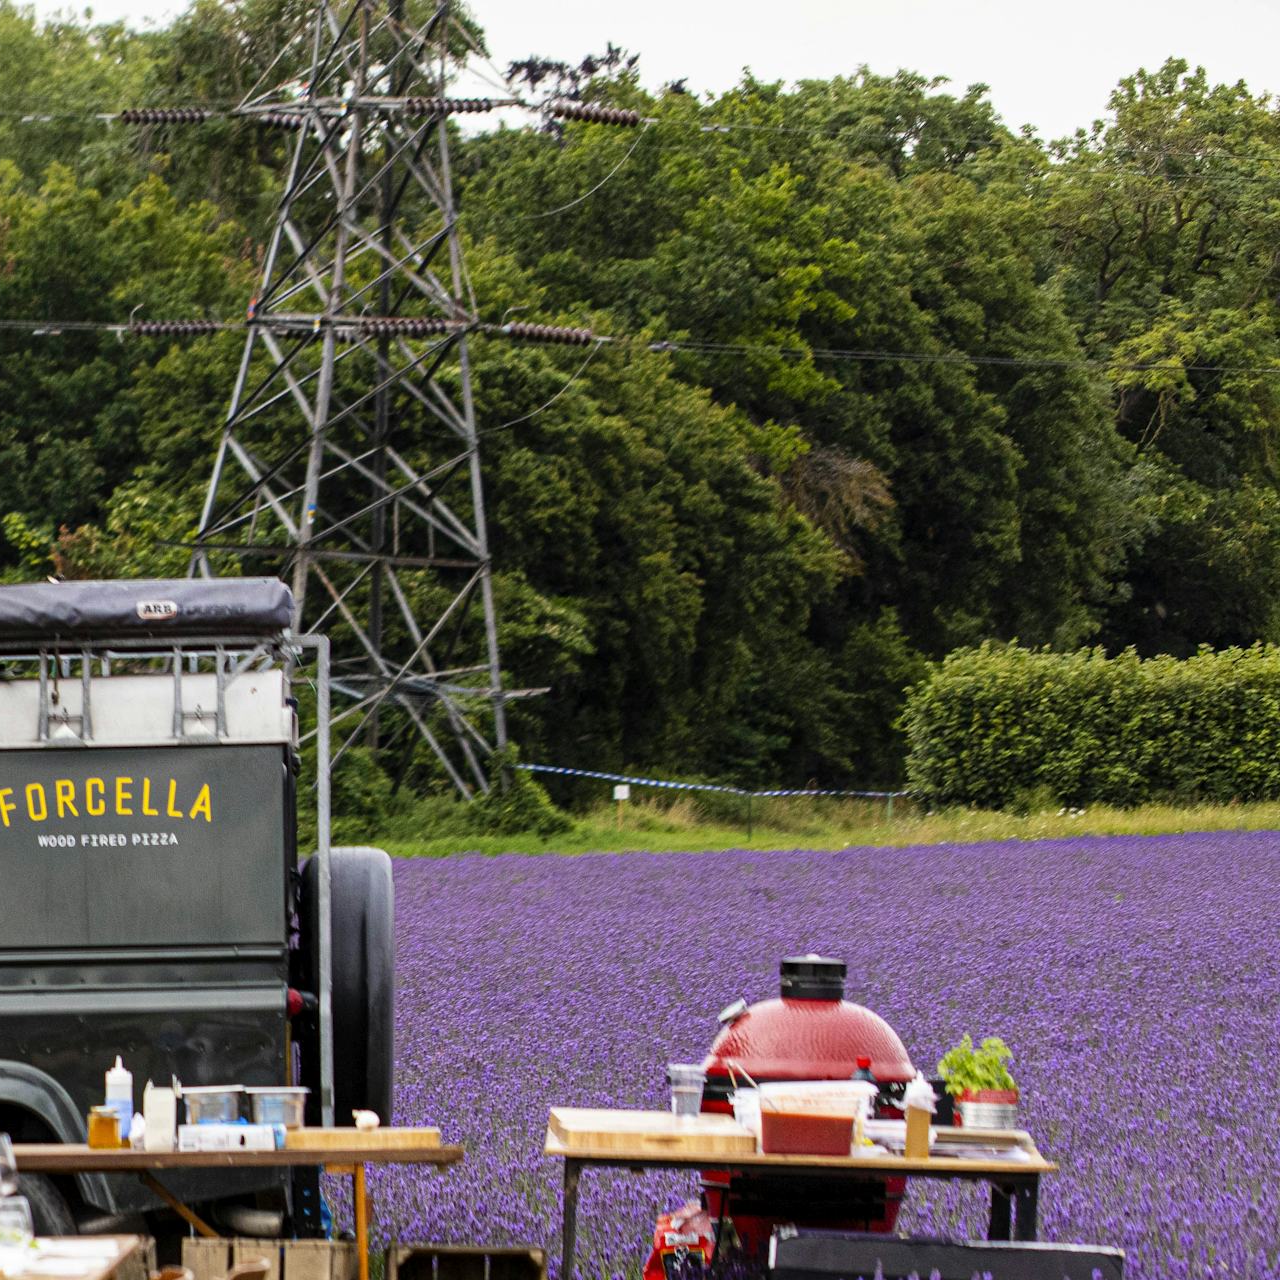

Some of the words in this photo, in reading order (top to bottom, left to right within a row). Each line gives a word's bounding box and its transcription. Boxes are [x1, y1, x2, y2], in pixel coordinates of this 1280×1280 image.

[38, 834, 76, 847] WOOD
[81, 833, 127, 847] FIRED
[132, 832, 179, 846] PIZZA
